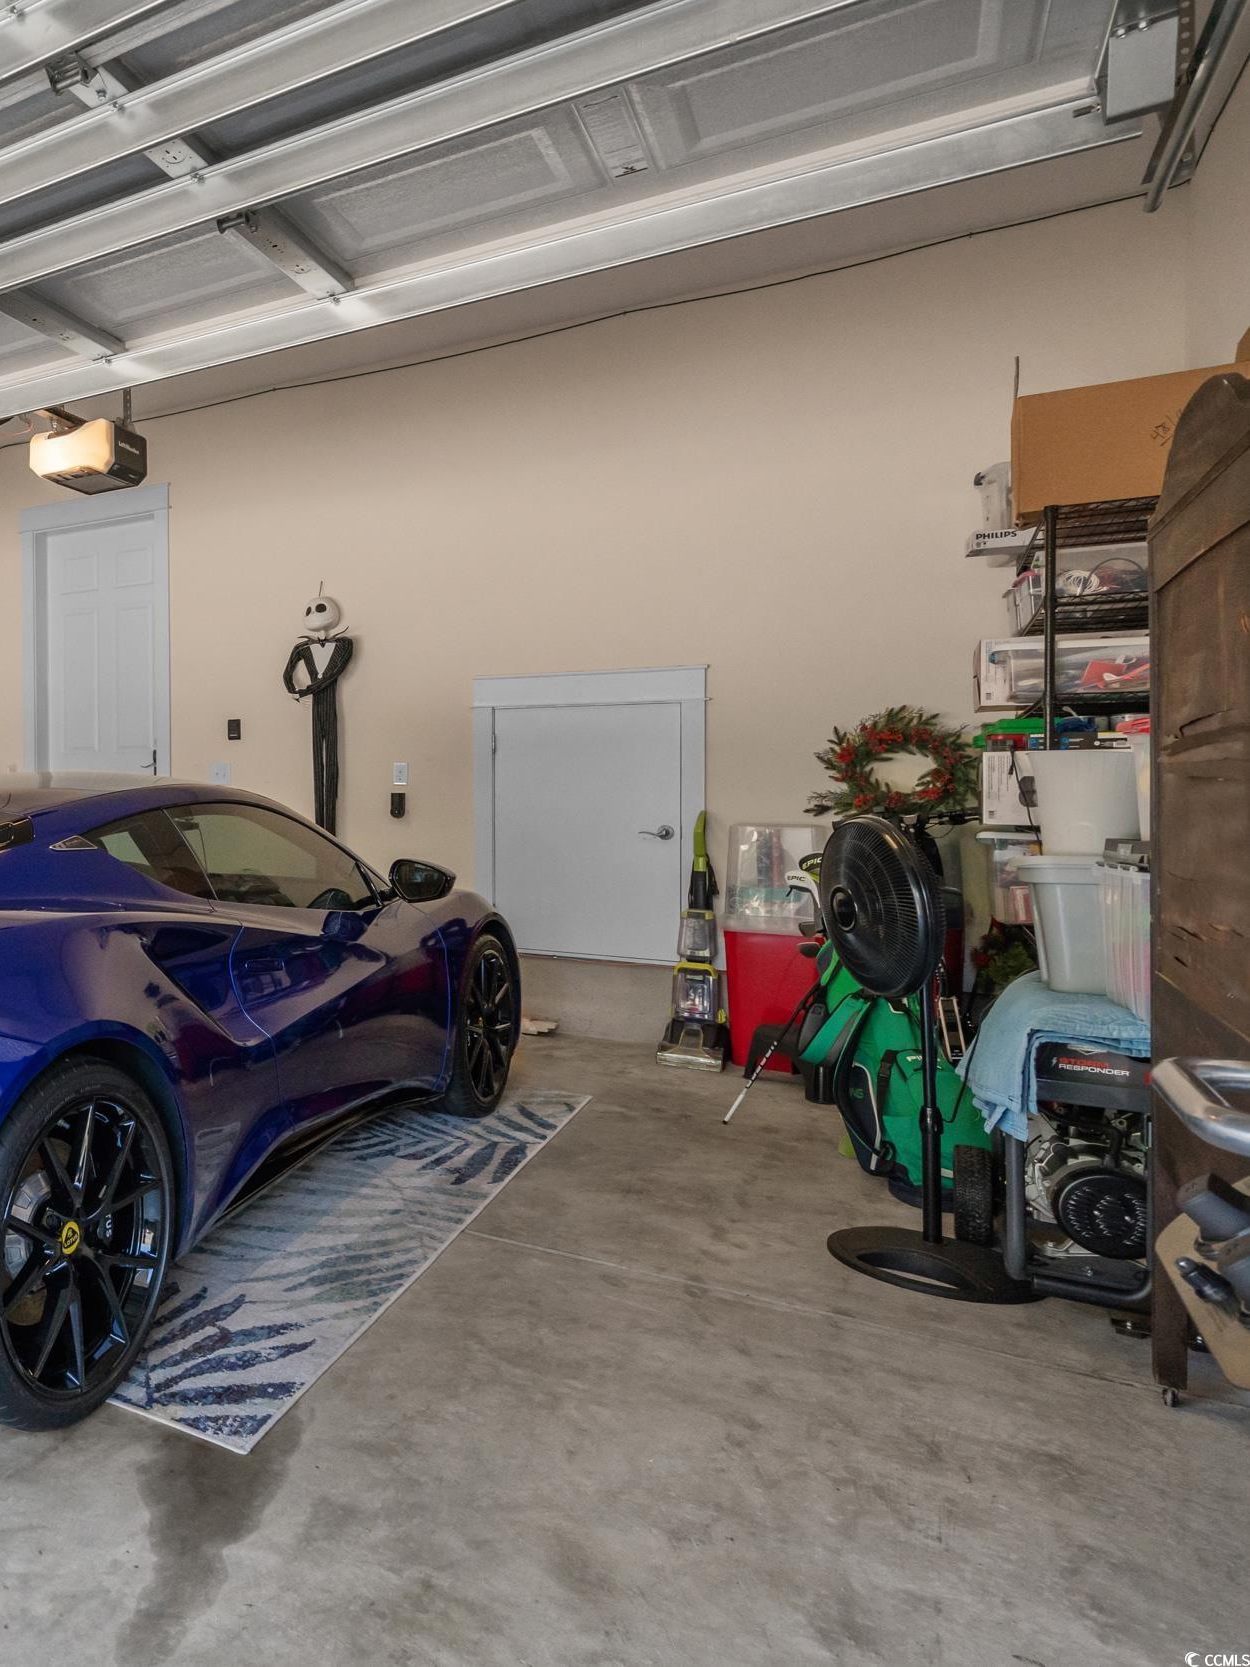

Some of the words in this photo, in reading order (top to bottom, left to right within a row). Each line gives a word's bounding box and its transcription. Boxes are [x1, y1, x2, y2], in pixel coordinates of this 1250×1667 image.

[975, 530, 1017, 540] PHILIPS
[802, 856, 822, 869] EPIC
[1058, 1056, 1110, 1069] STORM
[1058, 1063, 1130, 1077] RESPONDER
[64, 1232, 79, 1248] LOTUS
